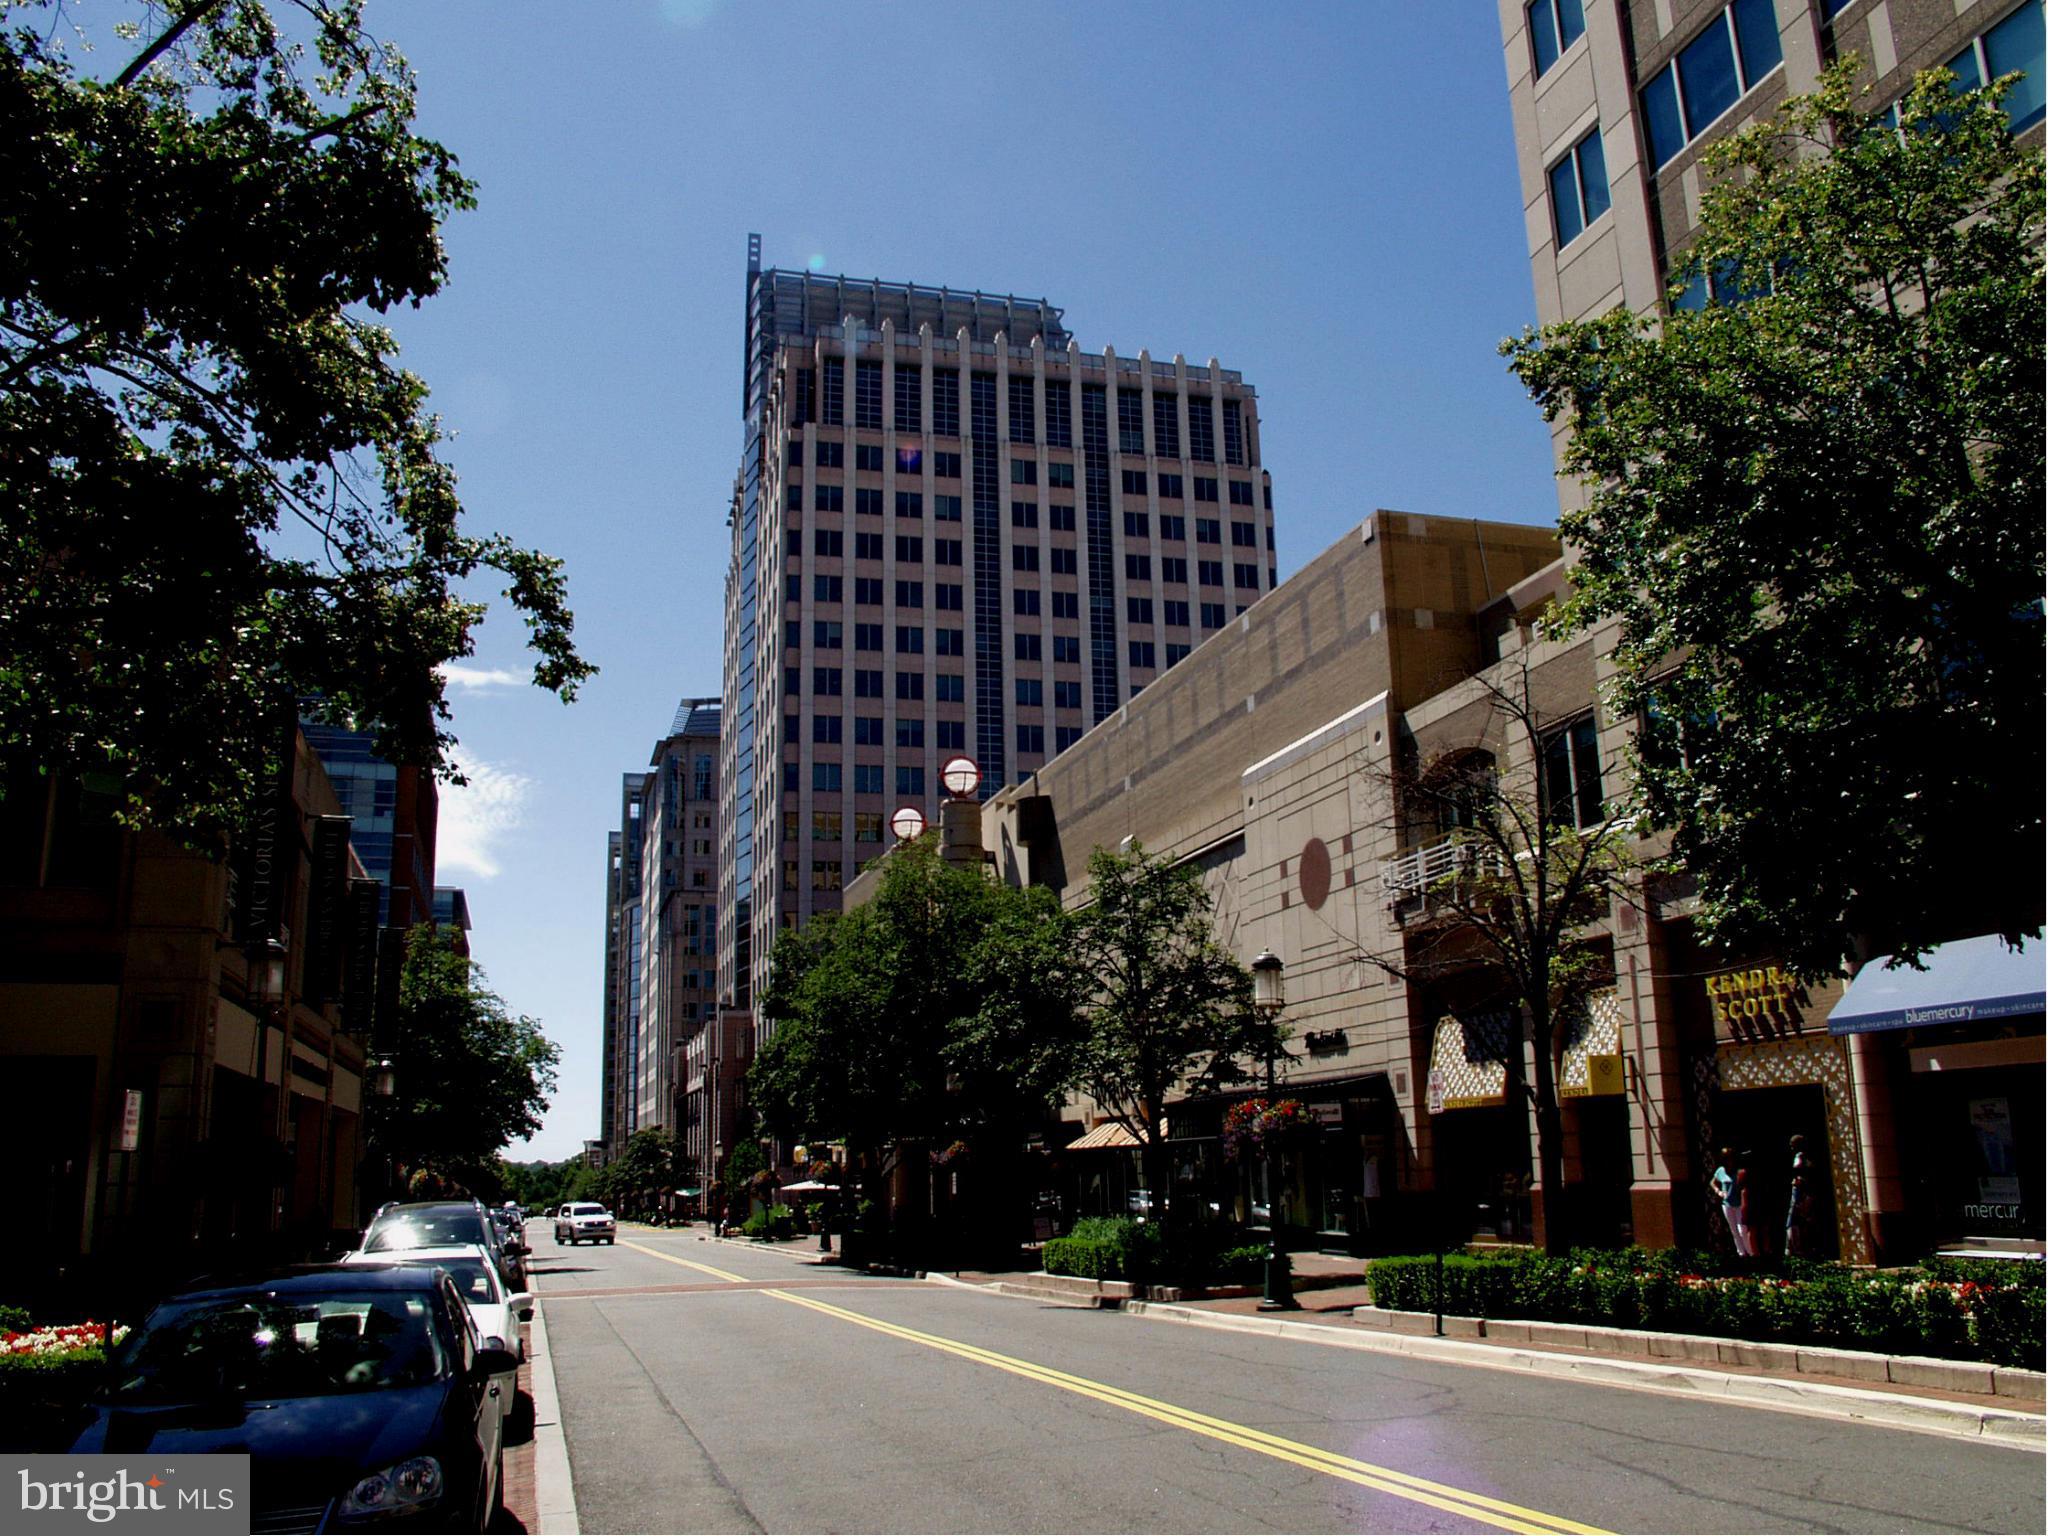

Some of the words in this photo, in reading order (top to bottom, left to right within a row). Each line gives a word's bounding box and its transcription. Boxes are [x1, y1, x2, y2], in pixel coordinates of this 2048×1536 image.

[1717, 993, 1788, 1021] SCOTT
[1905, 1005, 1974, 1024] bluemercury
[1963, 1203, 2027, 1224] mercur
